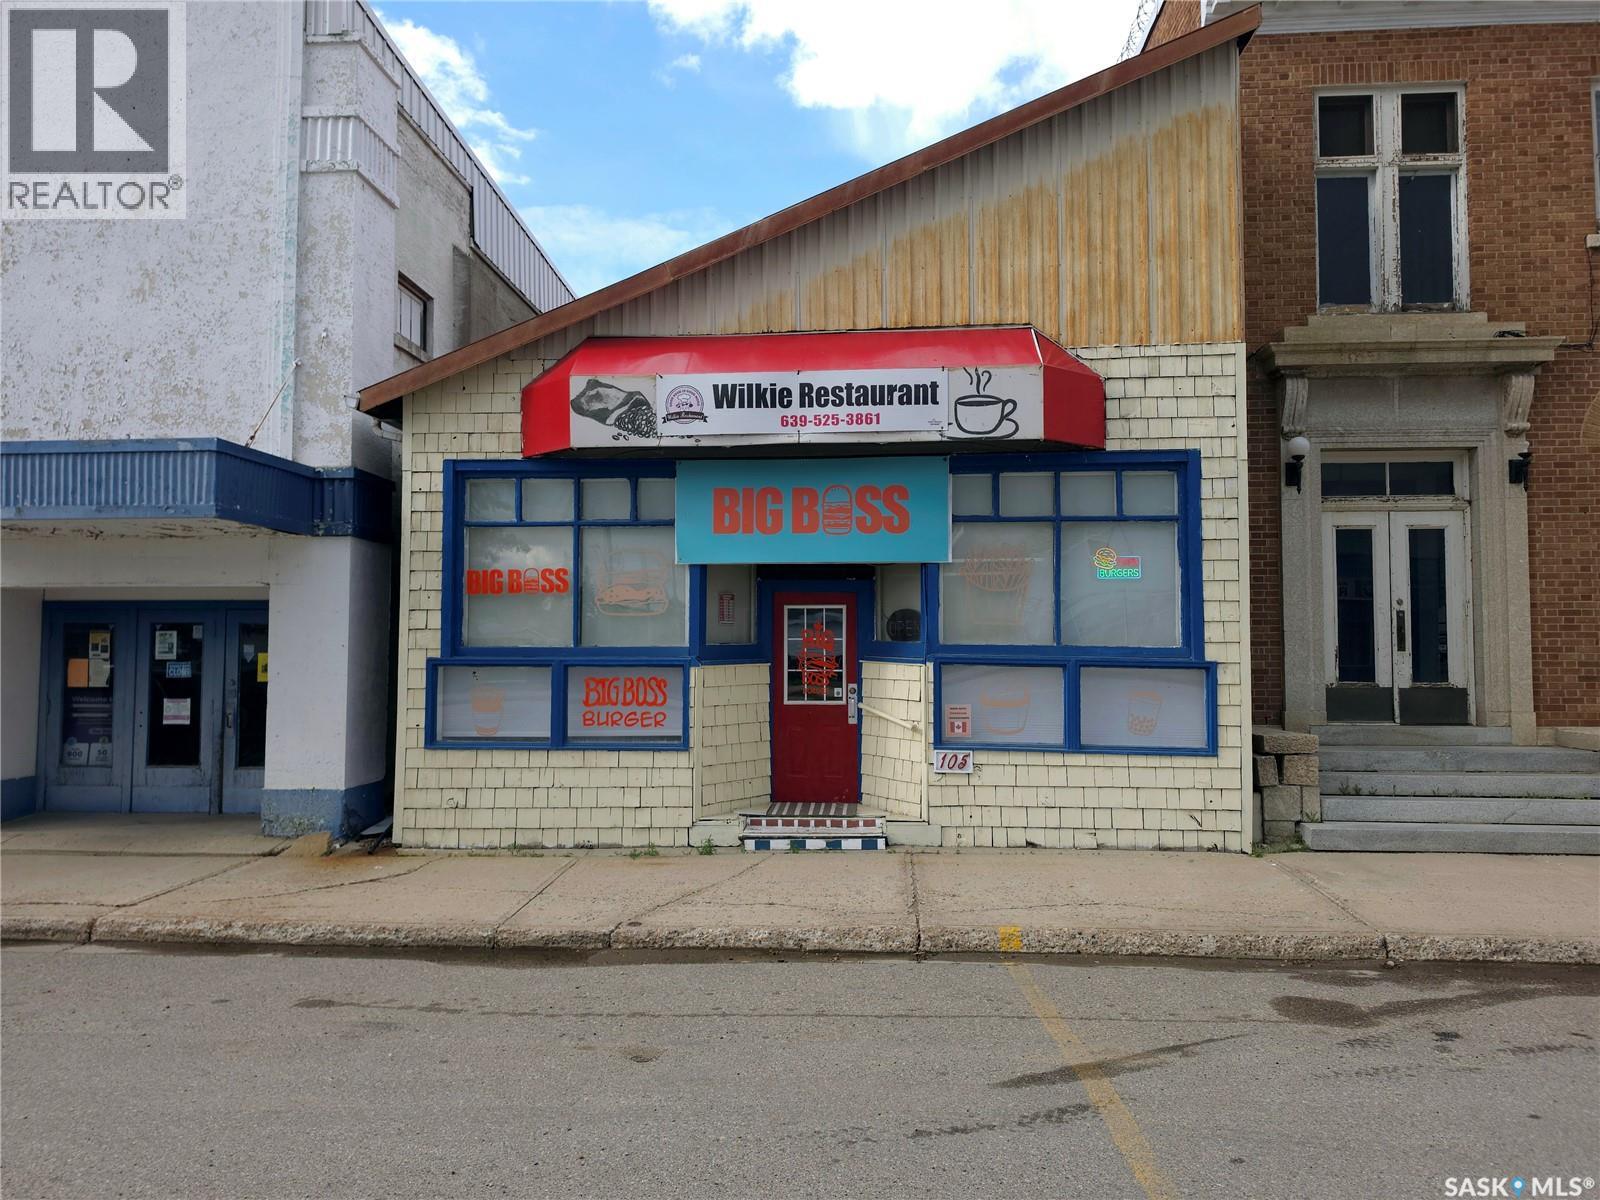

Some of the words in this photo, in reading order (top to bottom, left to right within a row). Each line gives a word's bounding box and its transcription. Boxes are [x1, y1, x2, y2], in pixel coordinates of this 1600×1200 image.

[712, 382, 793, 409] Wilkie
[798, 380, 940, 408] Restaurant
[780, 412, 881, 427] 639-525-3861
[712, 487, 784, 534] BIG
[465, 568, 504, 595] BIG
[1099, 568, 1139, 578] BURGERS
[583, 677, 619, 707] BIG
[622, 676, 668, 707] BOSS
[582, 710, 667, 728] BURGER
[938, 751, 971, 770] 105
